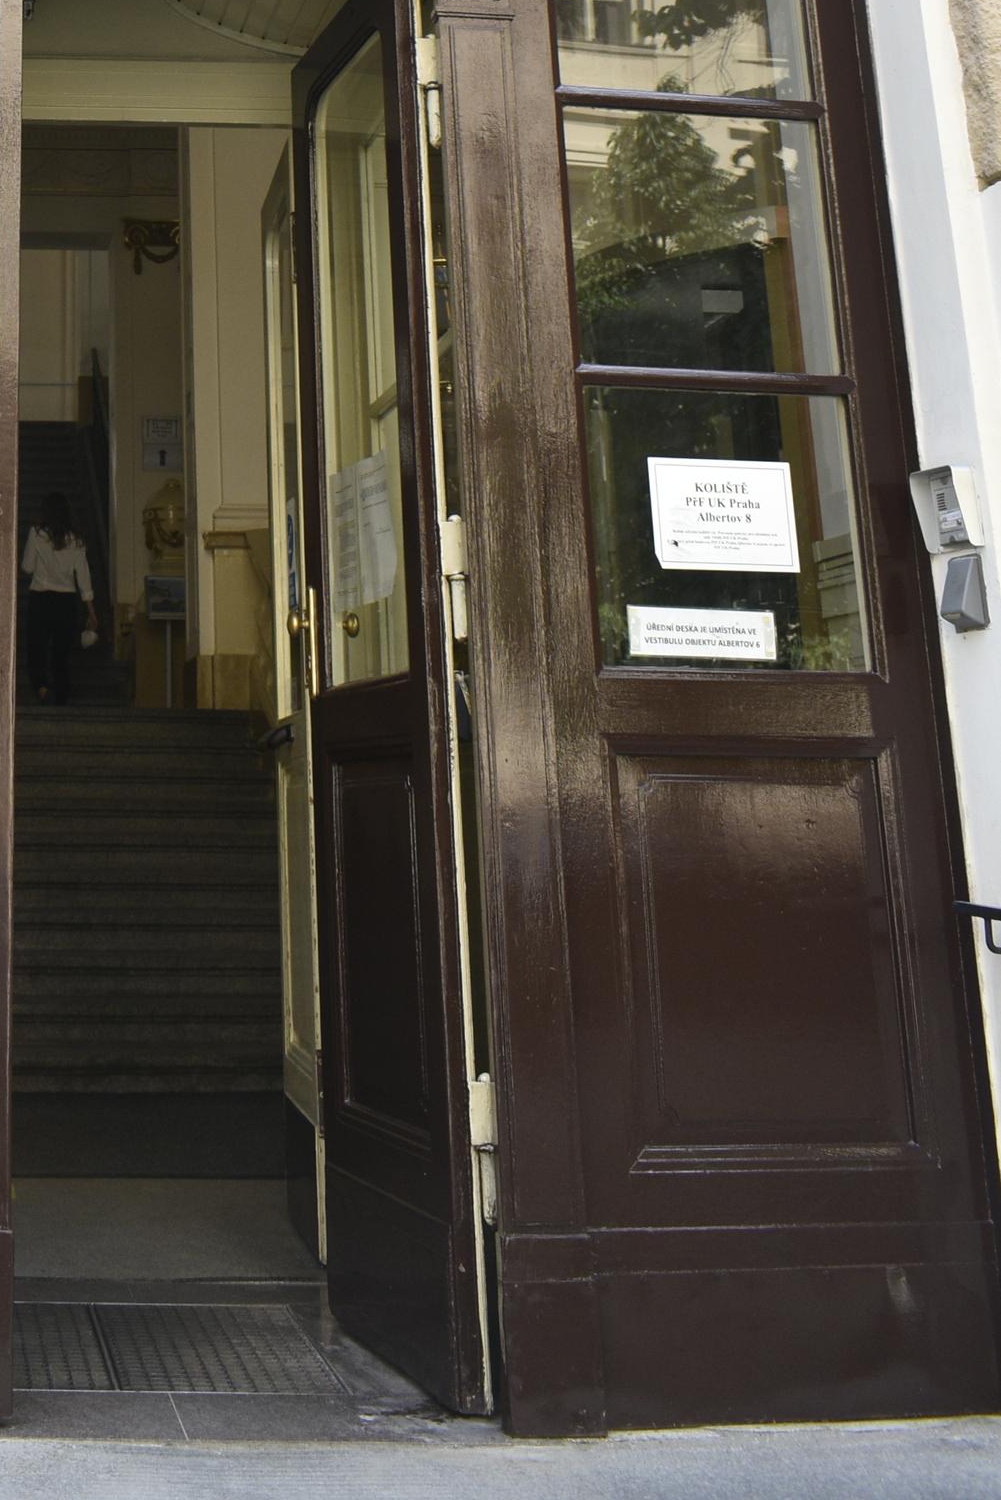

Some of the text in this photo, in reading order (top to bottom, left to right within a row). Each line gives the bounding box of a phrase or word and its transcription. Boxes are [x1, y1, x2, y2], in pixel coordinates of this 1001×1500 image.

[694, 481, 749, 494] KOLIŠTĚ
[685, 496, 761, 509] PřF UK Praha
[697, 512, 752, 523] Albertov 8
[646, 622, 674, 632] ÚŘEDNÍ
[675, 625, 698, 633] DESKA
[709, 625, 746, 635] UMÍSTĚNA
[644, 636, 683, 645] VESTIBULU
[685, 637, 716, 646] OBJEKTU
[718, 639, 755, 648] ALBERTOV
